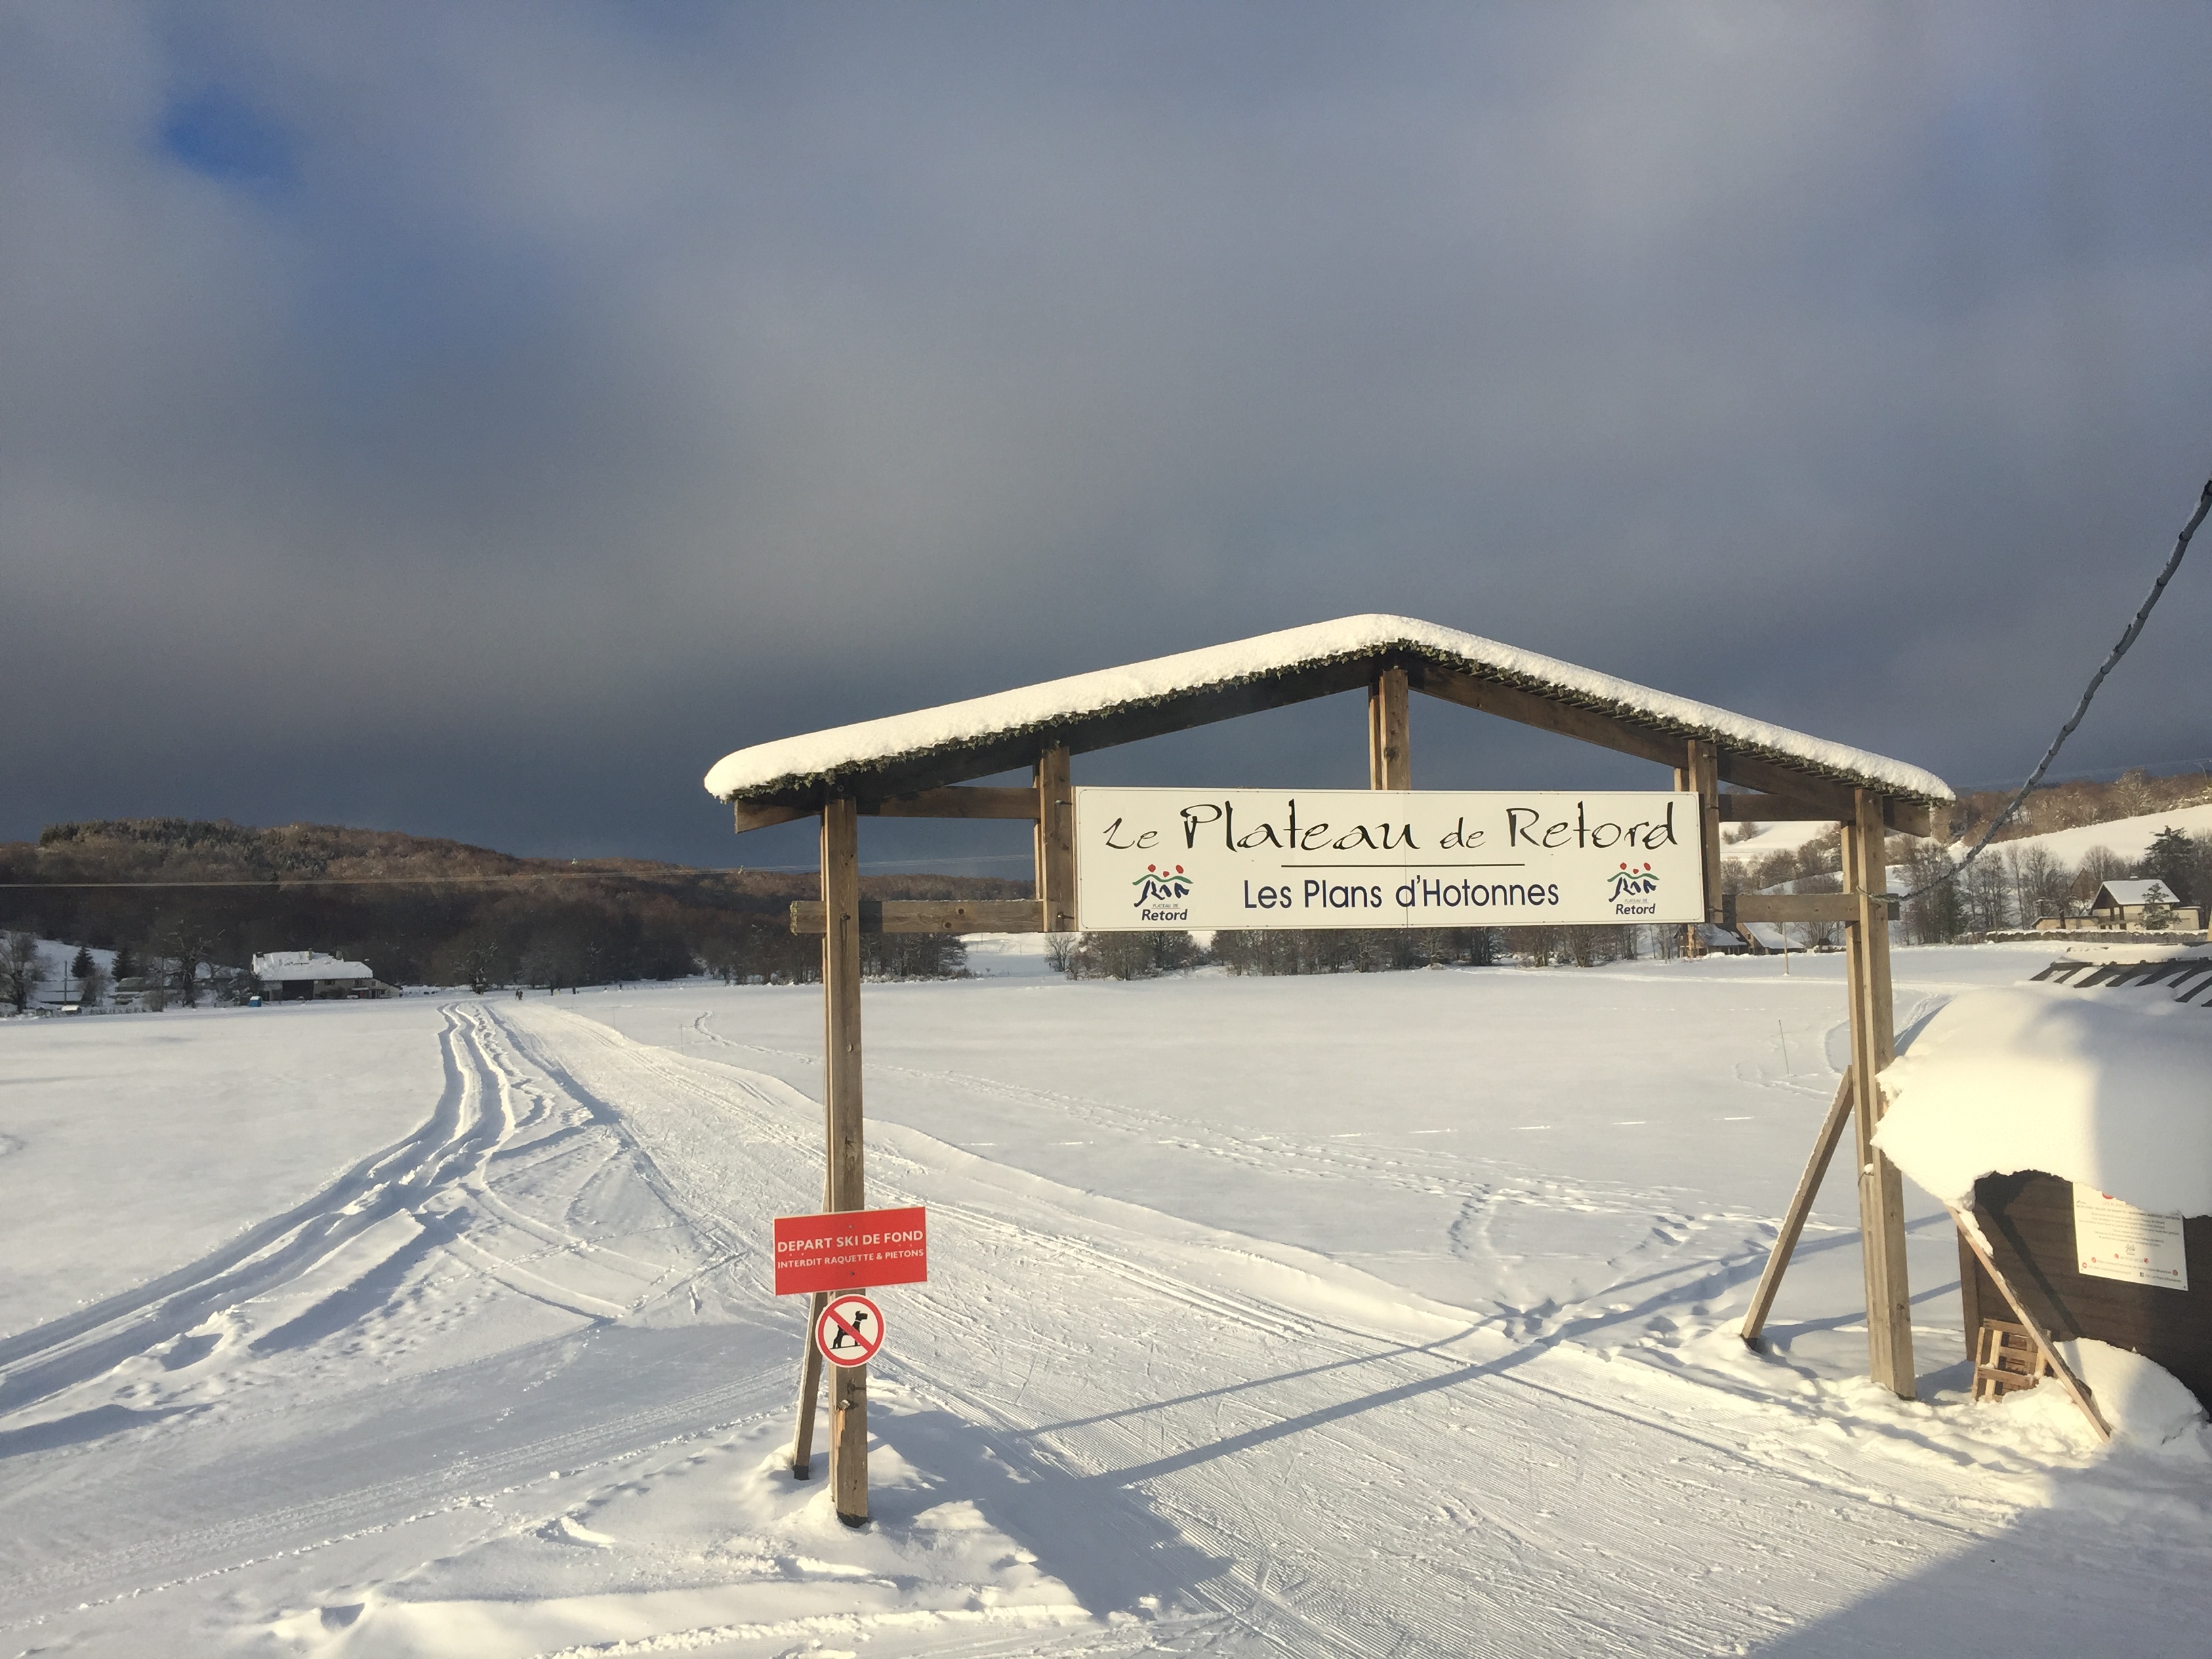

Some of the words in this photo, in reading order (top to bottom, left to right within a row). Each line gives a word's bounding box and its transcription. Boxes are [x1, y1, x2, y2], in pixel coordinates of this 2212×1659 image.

[1103, 817, 1159, 850] Le
[1179, 799, 1420, 853] Plateau
[1439, 817, 1486, 850] de
[1504, 800, 1679, 851] Retord
[1244, 880, 1292, 909] Les
[1304, 879, 1382, 909] Plans
[1395, 874, 1559, 908] d'Hotonnes
[1141, 909, 1188, 921] Retord
[1616, 903, 1656, 915] Retord
[777, 1237, 833, 1253] DEPART
[836, 1235, 859, 1248] SKI
[862, 1233, 880, 1245] DE
[884, 1230, 924, 1243] FOND
[777, 1257, 822, 1269] INTERDIT
[824, 1252, 874, 1265] RAQUETTE
[884, 1248, 924, 1260] PIETONS
